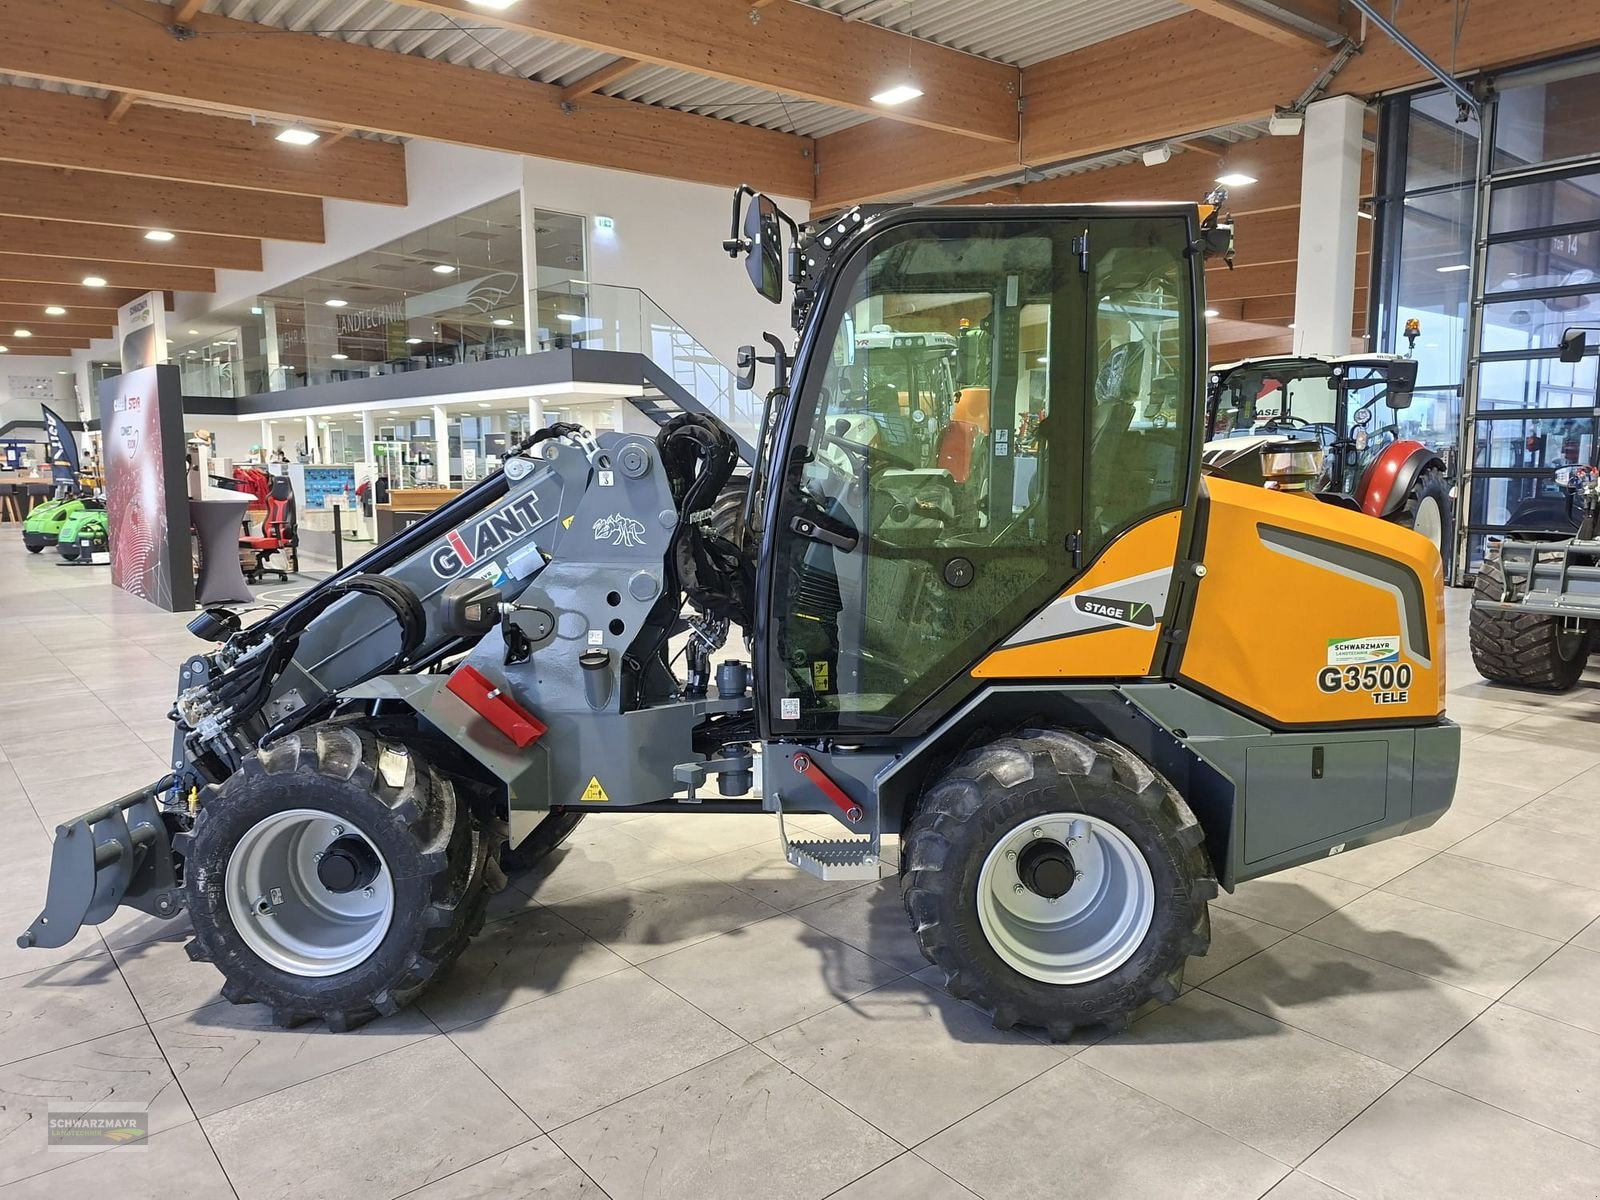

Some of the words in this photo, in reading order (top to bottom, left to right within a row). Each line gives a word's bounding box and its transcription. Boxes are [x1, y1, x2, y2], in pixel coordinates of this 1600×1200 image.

[1567, 234, 1578, 256] 14
[337, 300, 405, 335] LANDTECHNIK
[1084, 602, 1124, 618] STAGE
[1130, 601, 1147, 621] V
[1318, 663, 1412, 693] G3500
[1372, 691, 1408, 704] TELE
